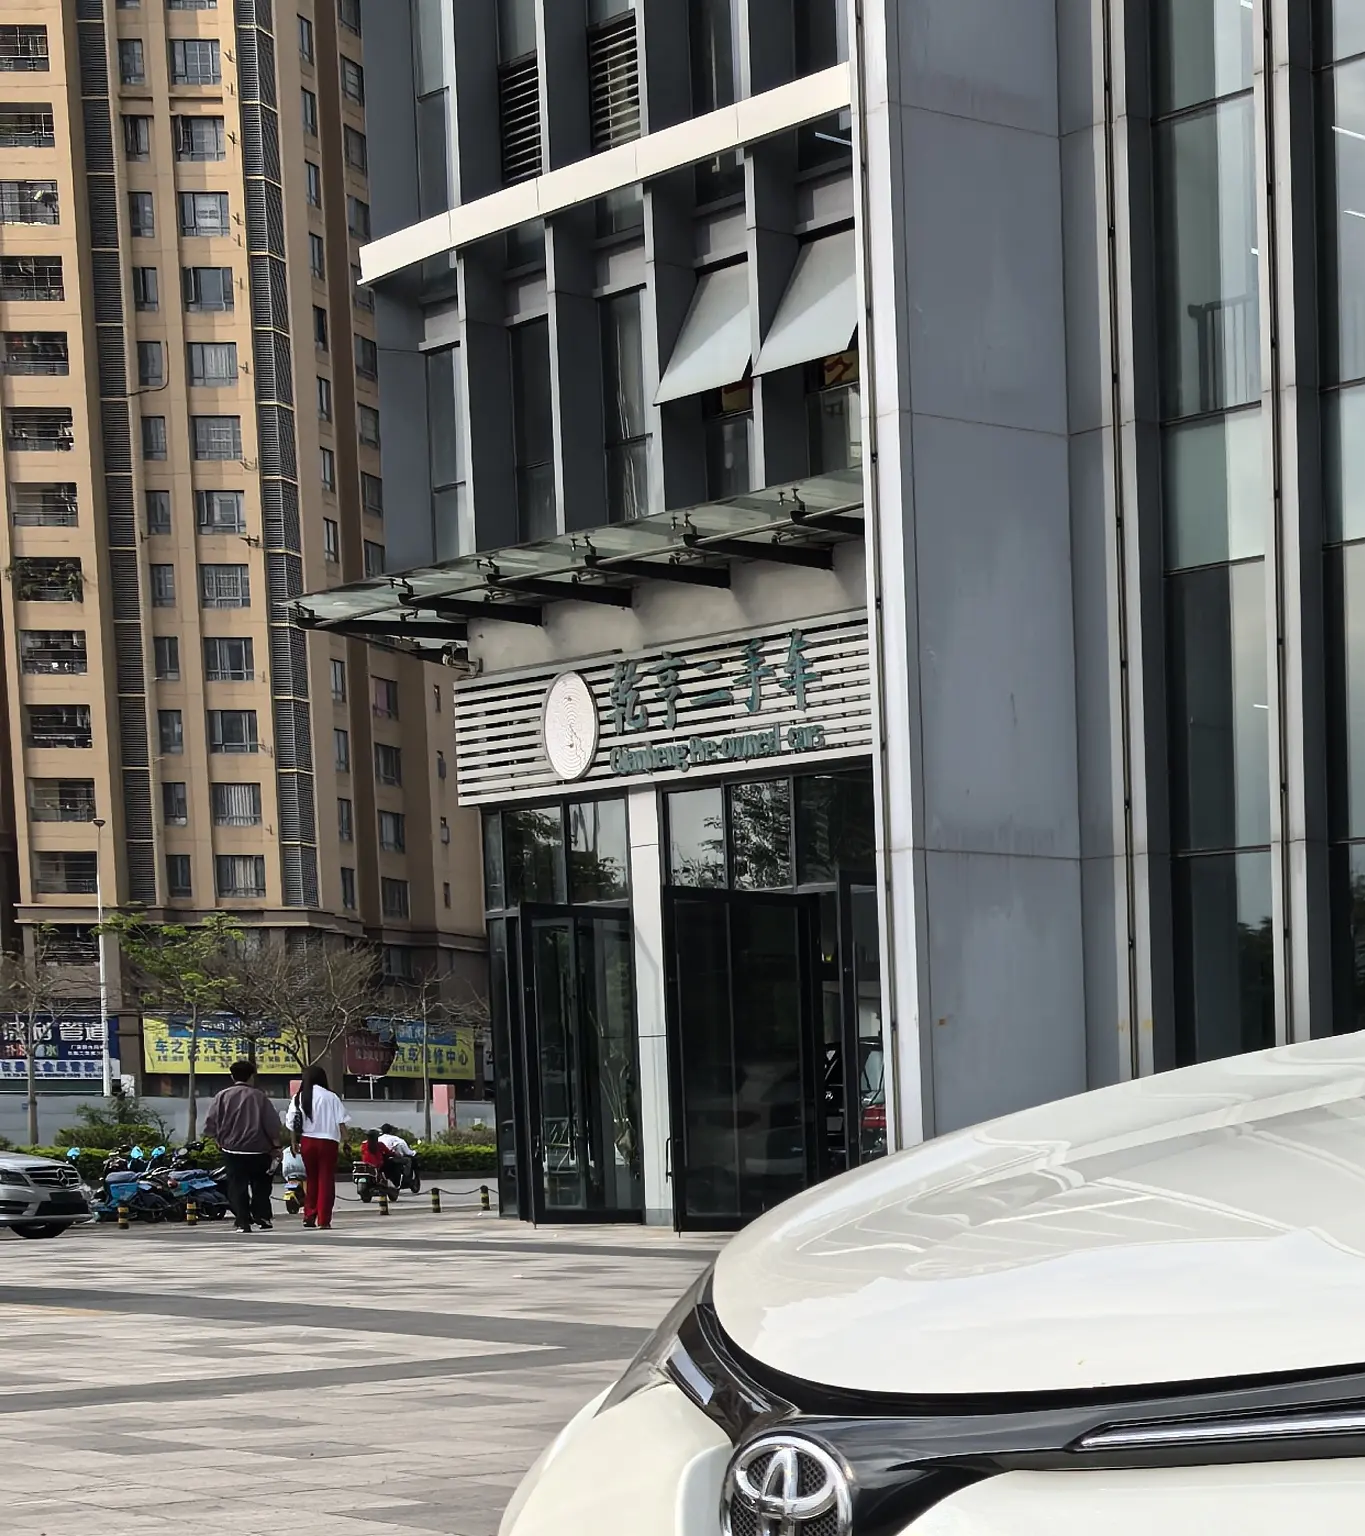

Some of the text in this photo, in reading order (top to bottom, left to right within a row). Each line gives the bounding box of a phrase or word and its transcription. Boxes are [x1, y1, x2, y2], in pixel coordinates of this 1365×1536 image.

[606, 628, 822, 734] 乾亨二手车
